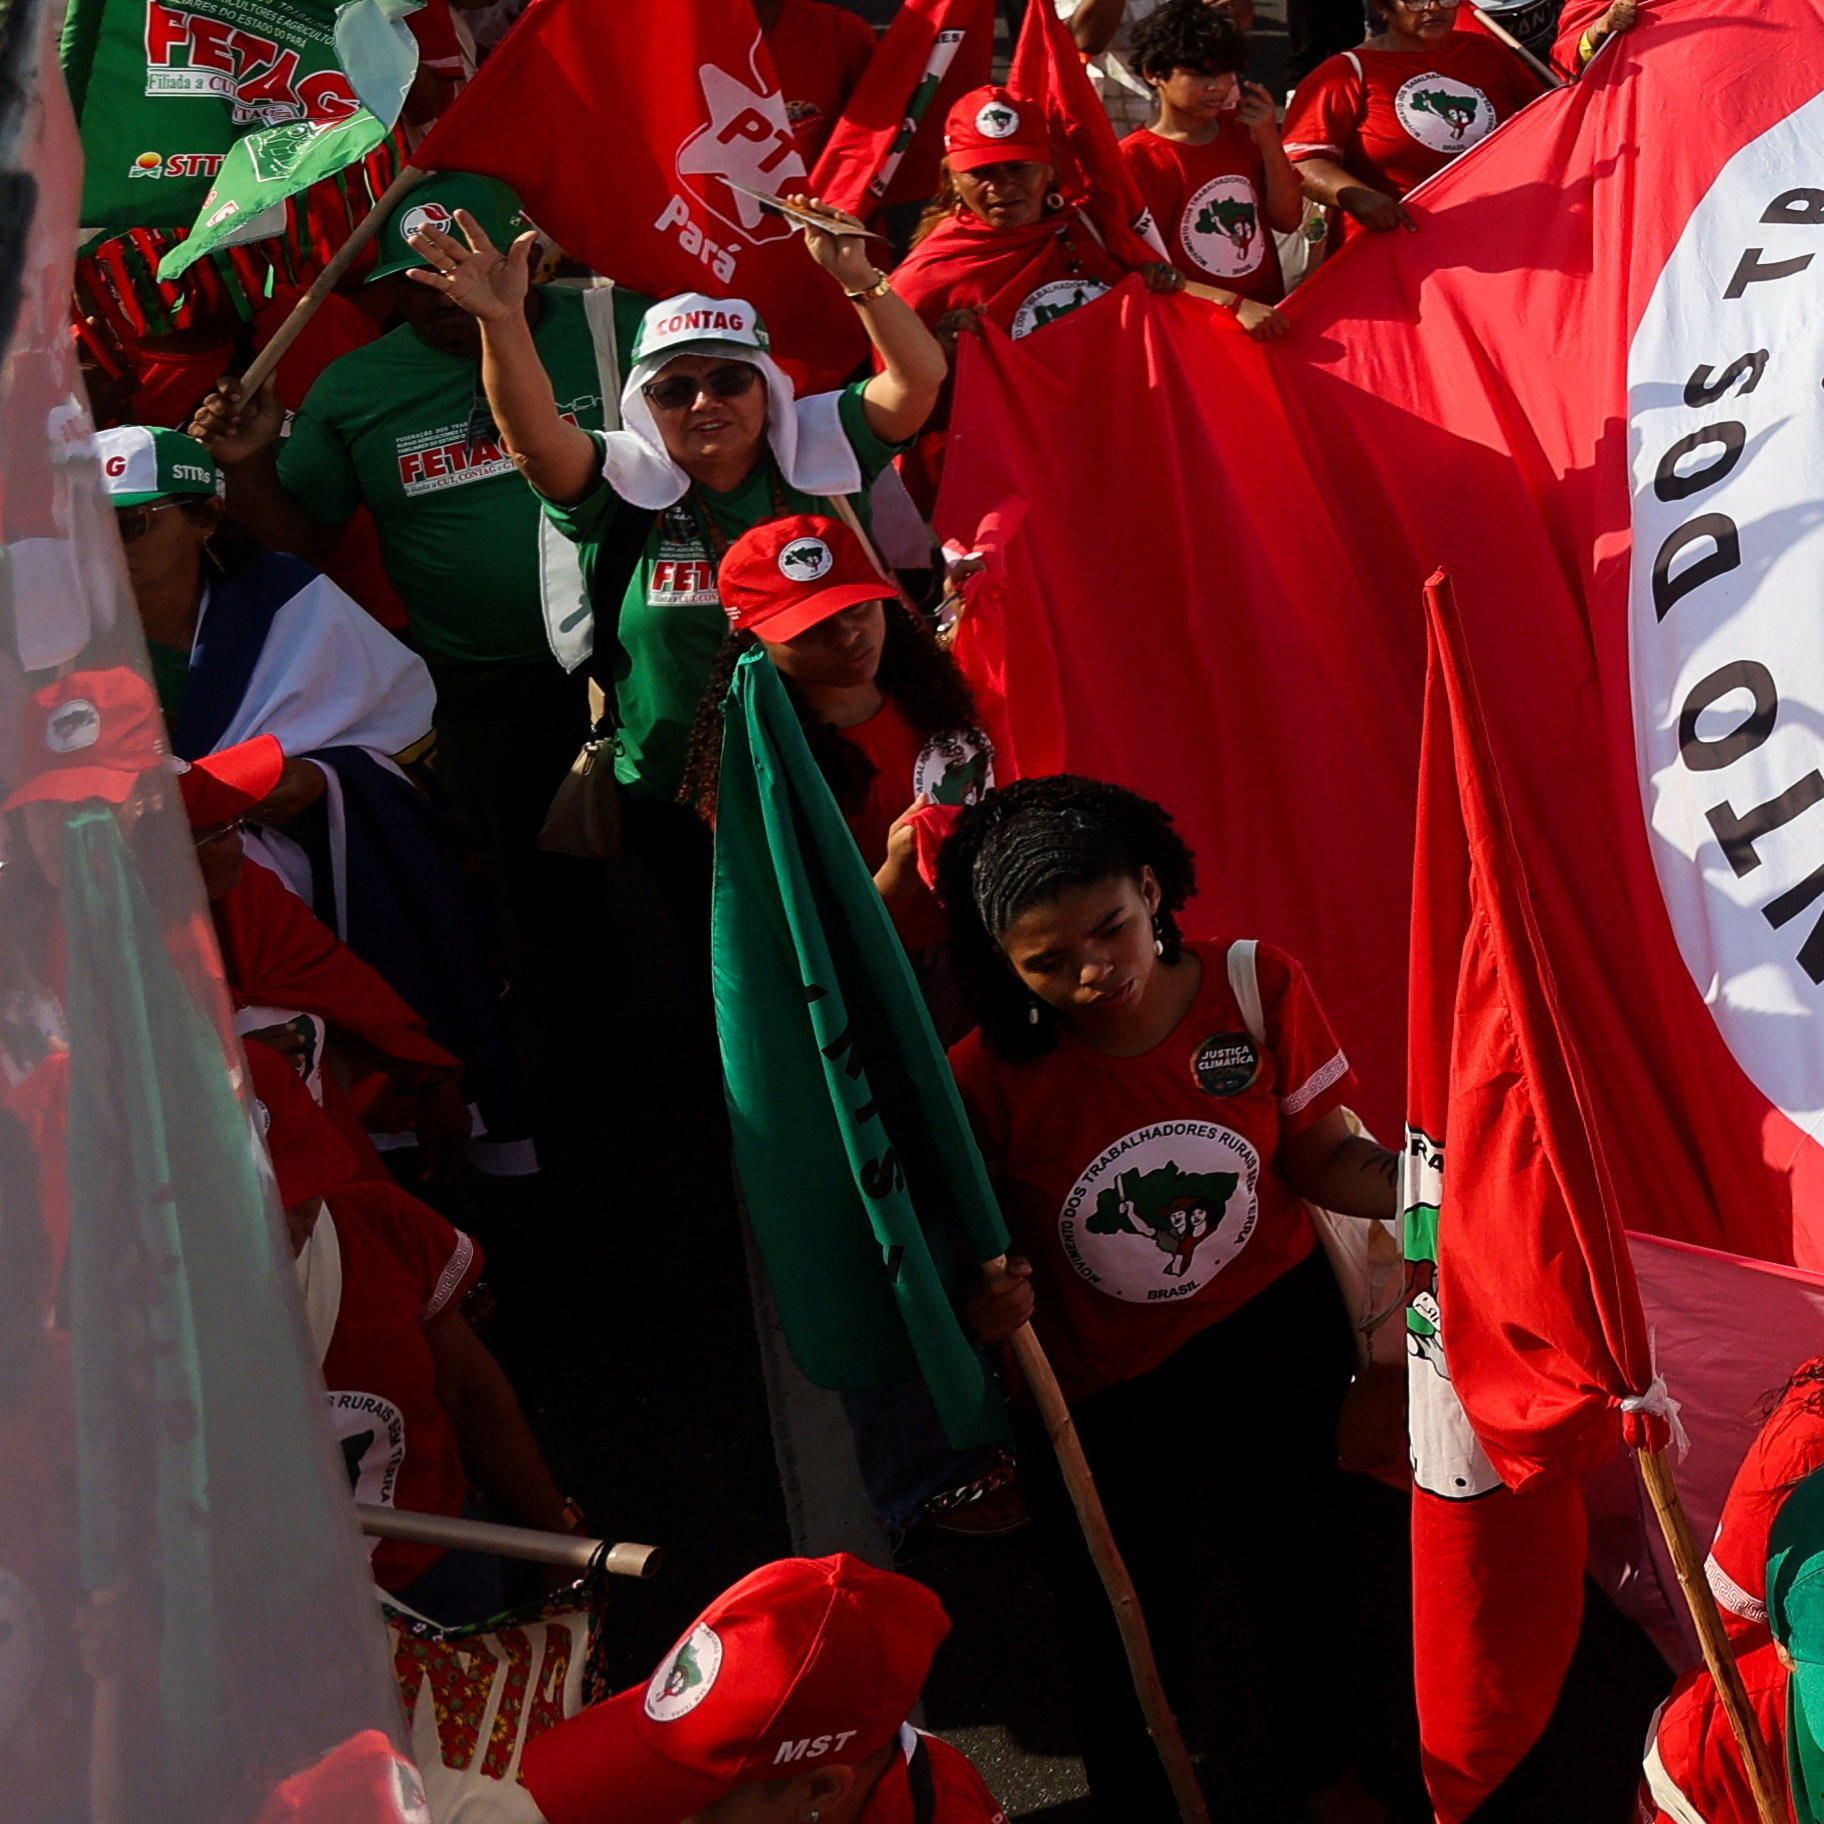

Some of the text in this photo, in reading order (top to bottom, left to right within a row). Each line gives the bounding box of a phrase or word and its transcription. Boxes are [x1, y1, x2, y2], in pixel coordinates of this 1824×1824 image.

[219, 5, 236, 21] DO
[236, 12, 273, 37] ESTADO
[146, 0, 360, 122] FETAG
[150, 74, 204, 93] Filiada a
[715, 105, 796, 174] PT
[654, 194, 736, 278] Pará
[655, 309, 745, 336] CONTAG
[1652, 348, 1768, 623] DOS
[1198, 1054, 1255, 1072] CLIMÁTICA
[1201, 1044, 1251, 1061] JUSTIÇA
[1080, 1122, 1220, 1187] TRABALHADORES
[1065, 1184, 1085, 1220] DOS
[1058, 1219, 1103, 1285] MOVIMENTO
[1146, 1278, 1202, 1303] BRASIL
[341, 1394, 394, 1424] RURAIS
[773, 1729, 857, 1764] MST
